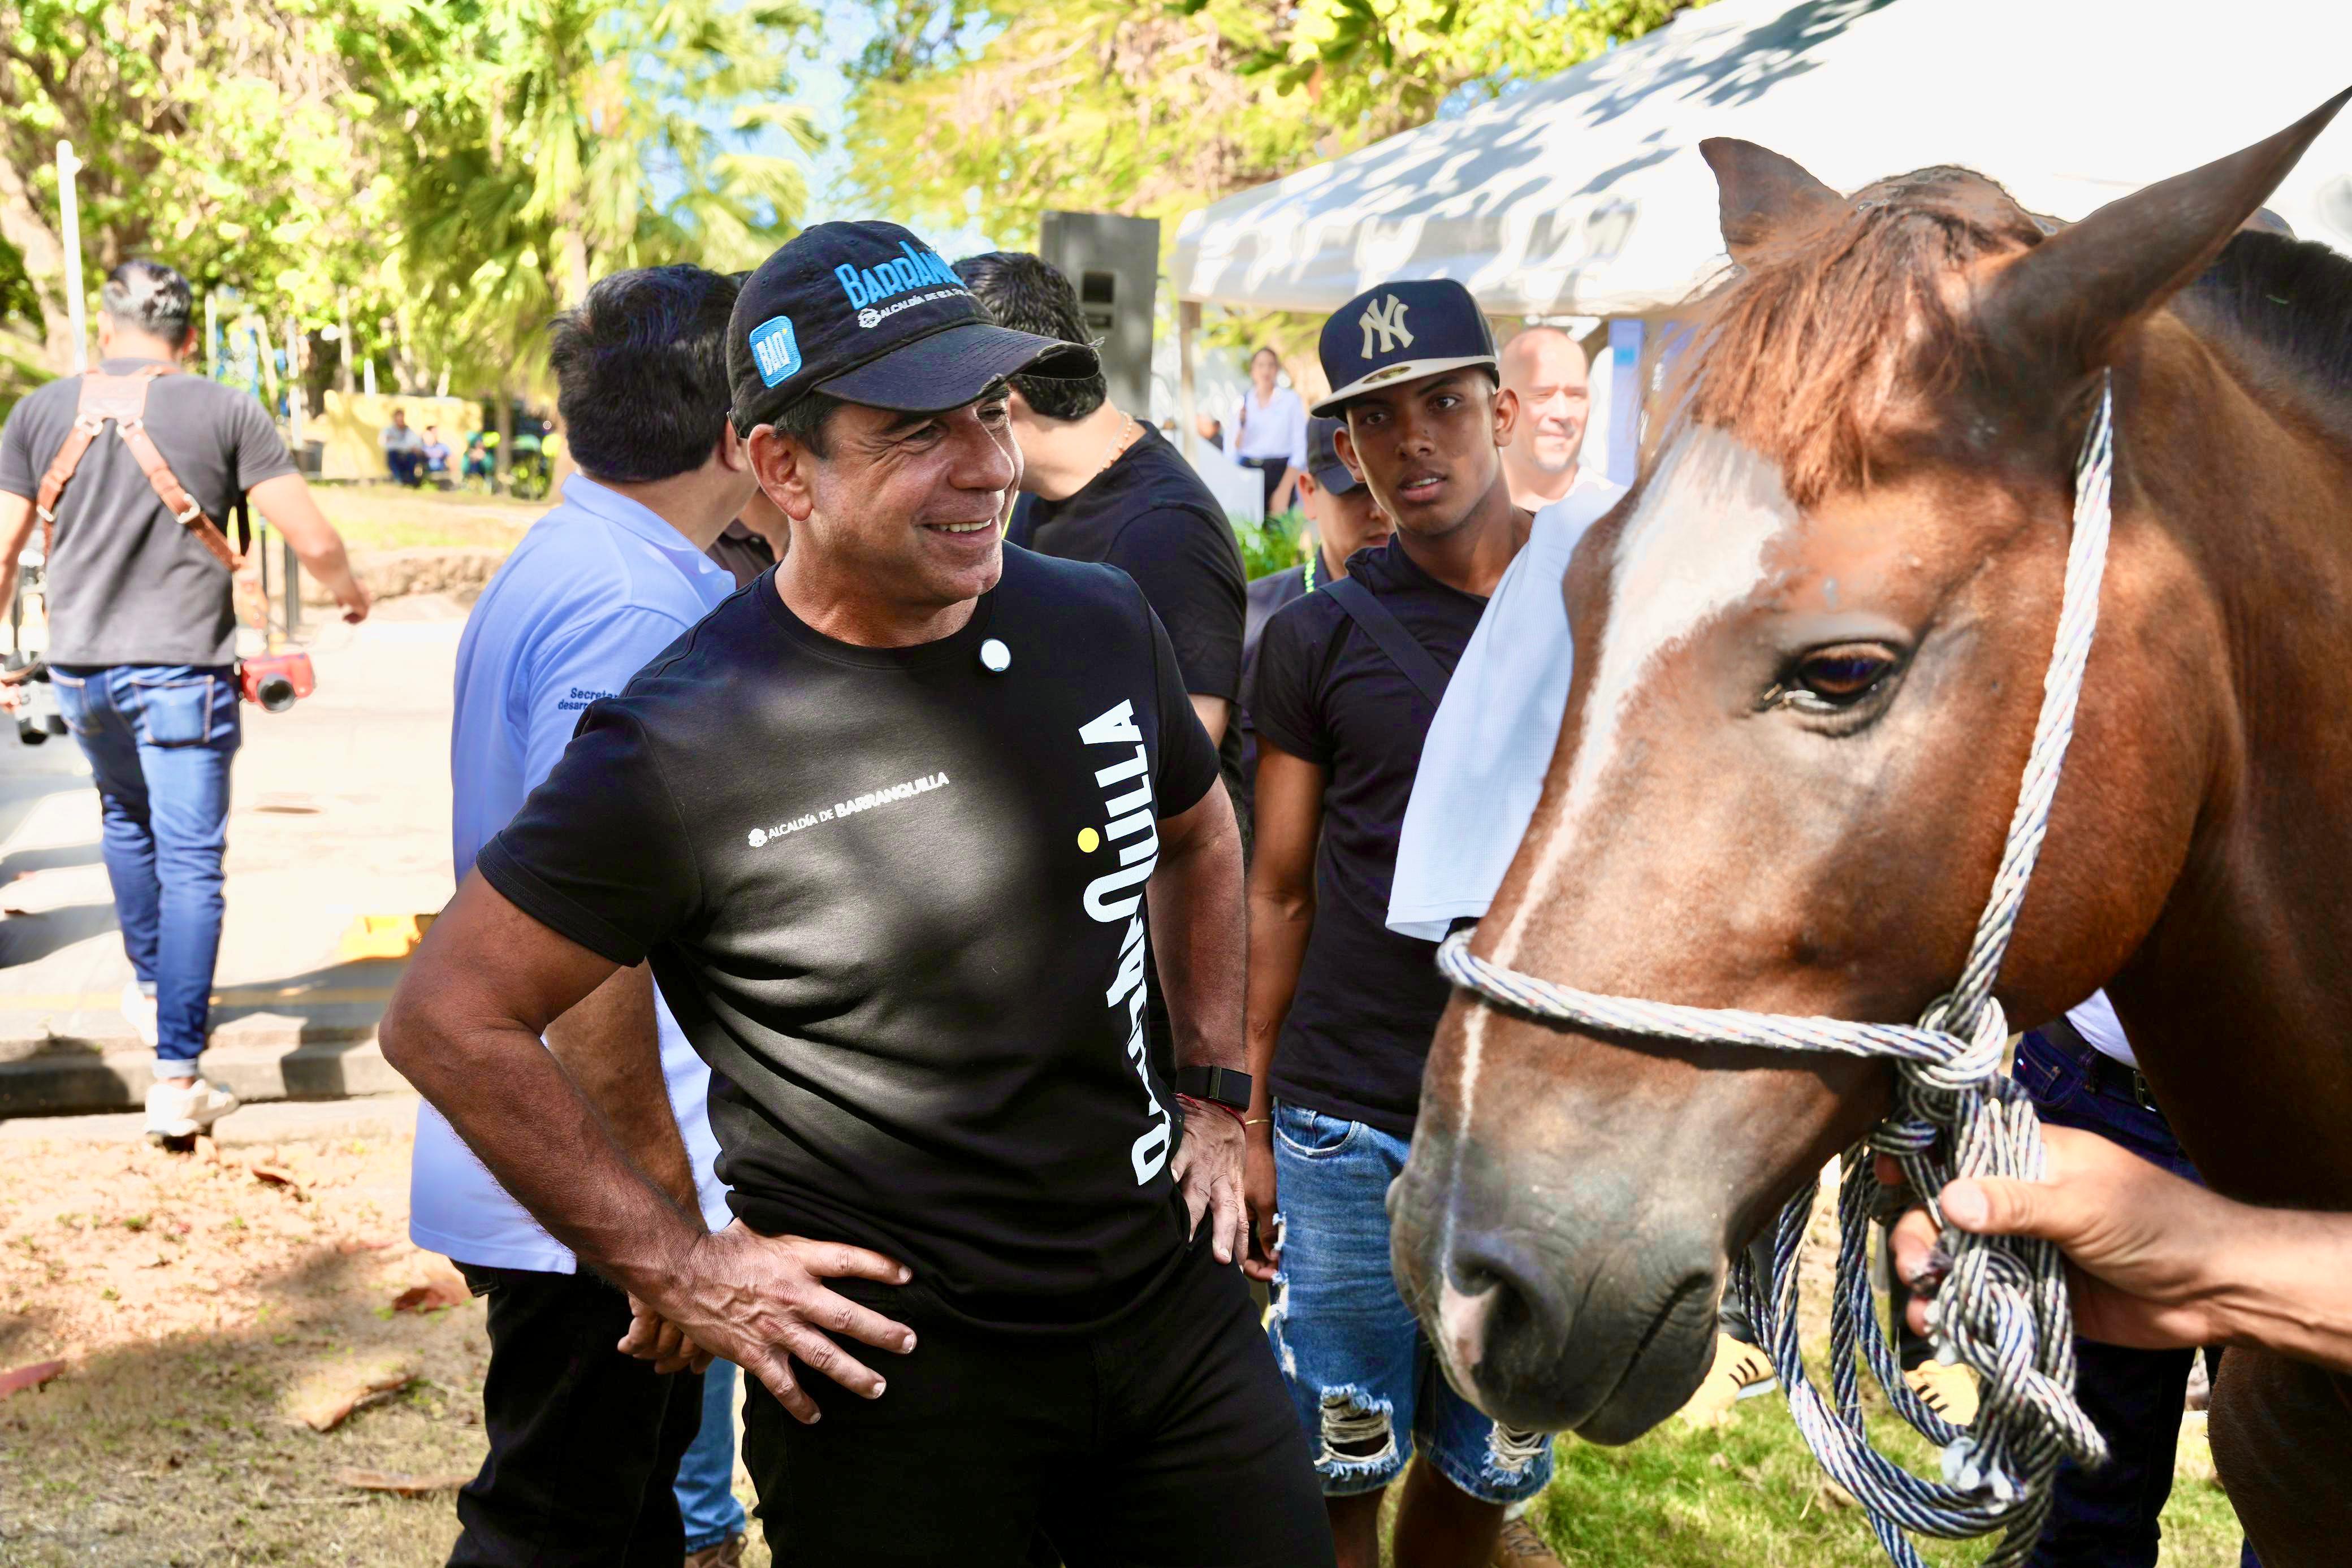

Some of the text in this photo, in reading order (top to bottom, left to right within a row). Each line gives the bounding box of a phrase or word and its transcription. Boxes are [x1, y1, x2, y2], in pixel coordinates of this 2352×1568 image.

[834, 240, 968, 310] BARRAN
[1359, 294, 1414, 359] NY
[768, 772, 949, 839] ALCALDÍA DE BARRANQUILLA
